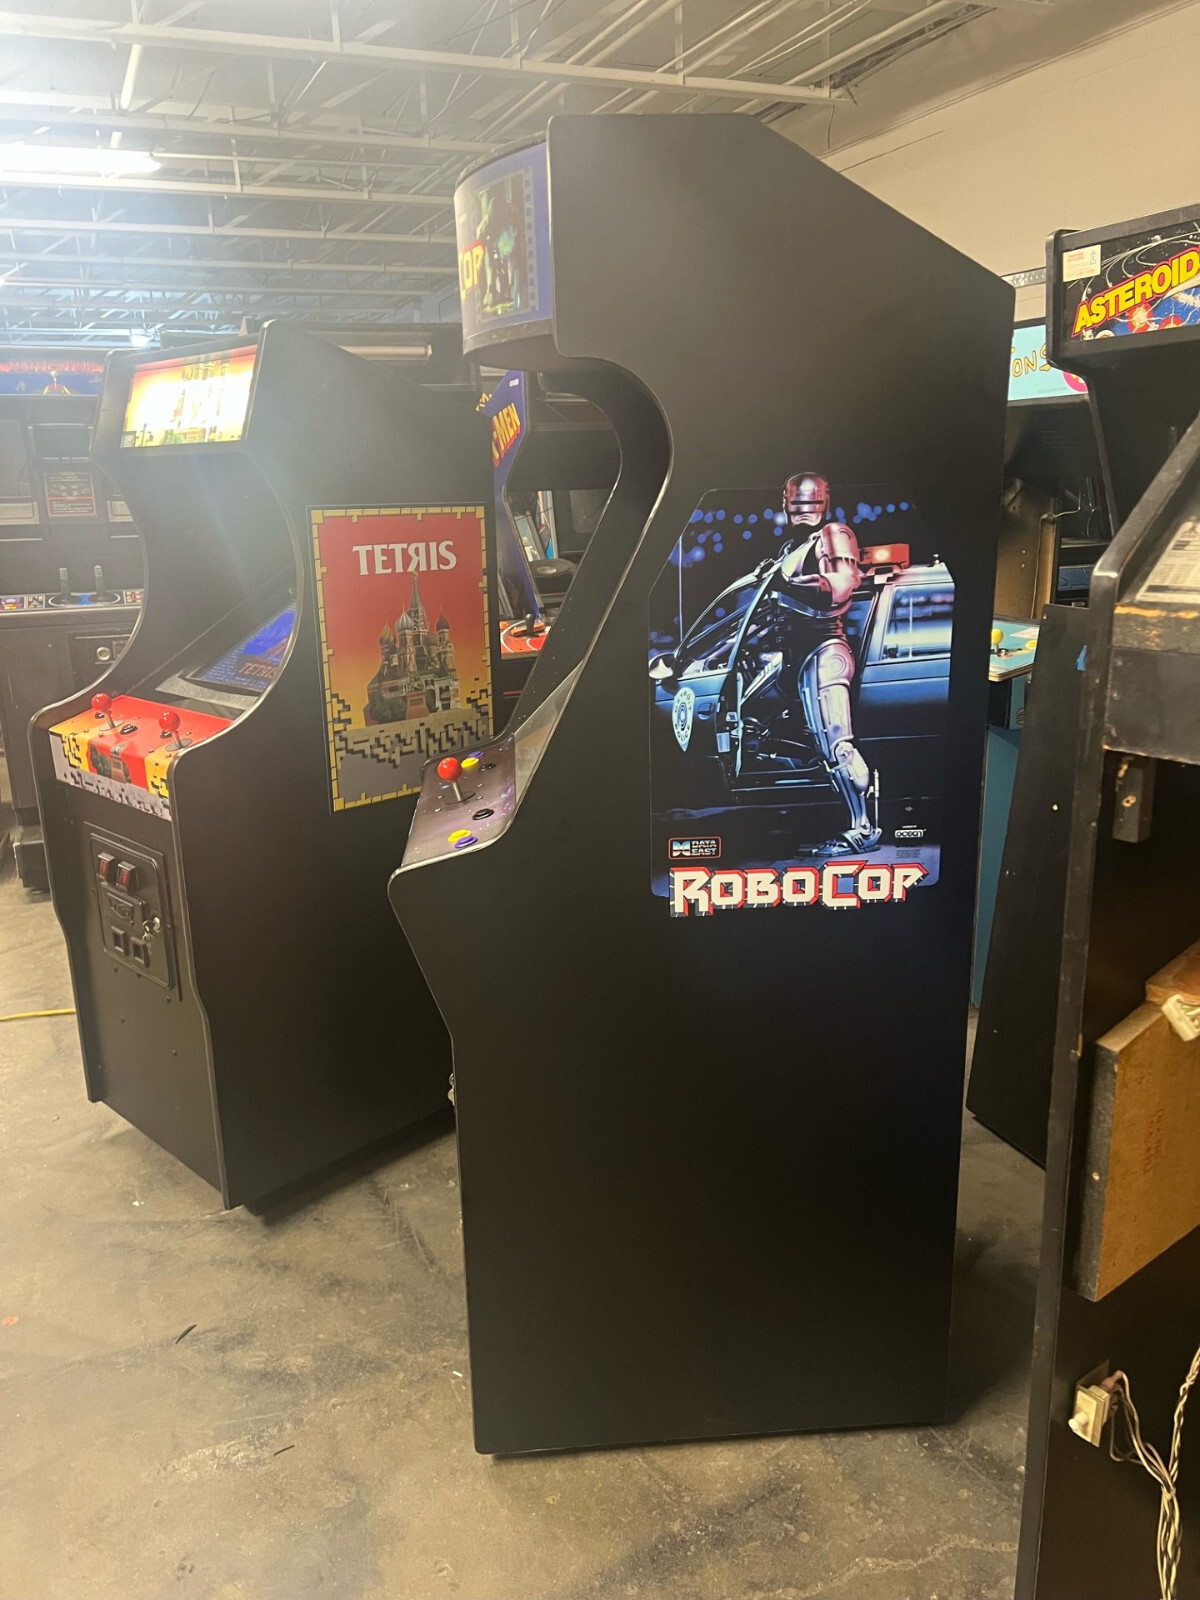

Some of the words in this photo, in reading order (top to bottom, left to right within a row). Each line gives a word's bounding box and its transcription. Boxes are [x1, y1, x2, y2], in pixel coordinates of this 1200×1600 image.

[1073, 249, 1200, 335] ASTEROID
[691, 840, 717, 848] DATA
[691, 848, 717, 856] EAST
